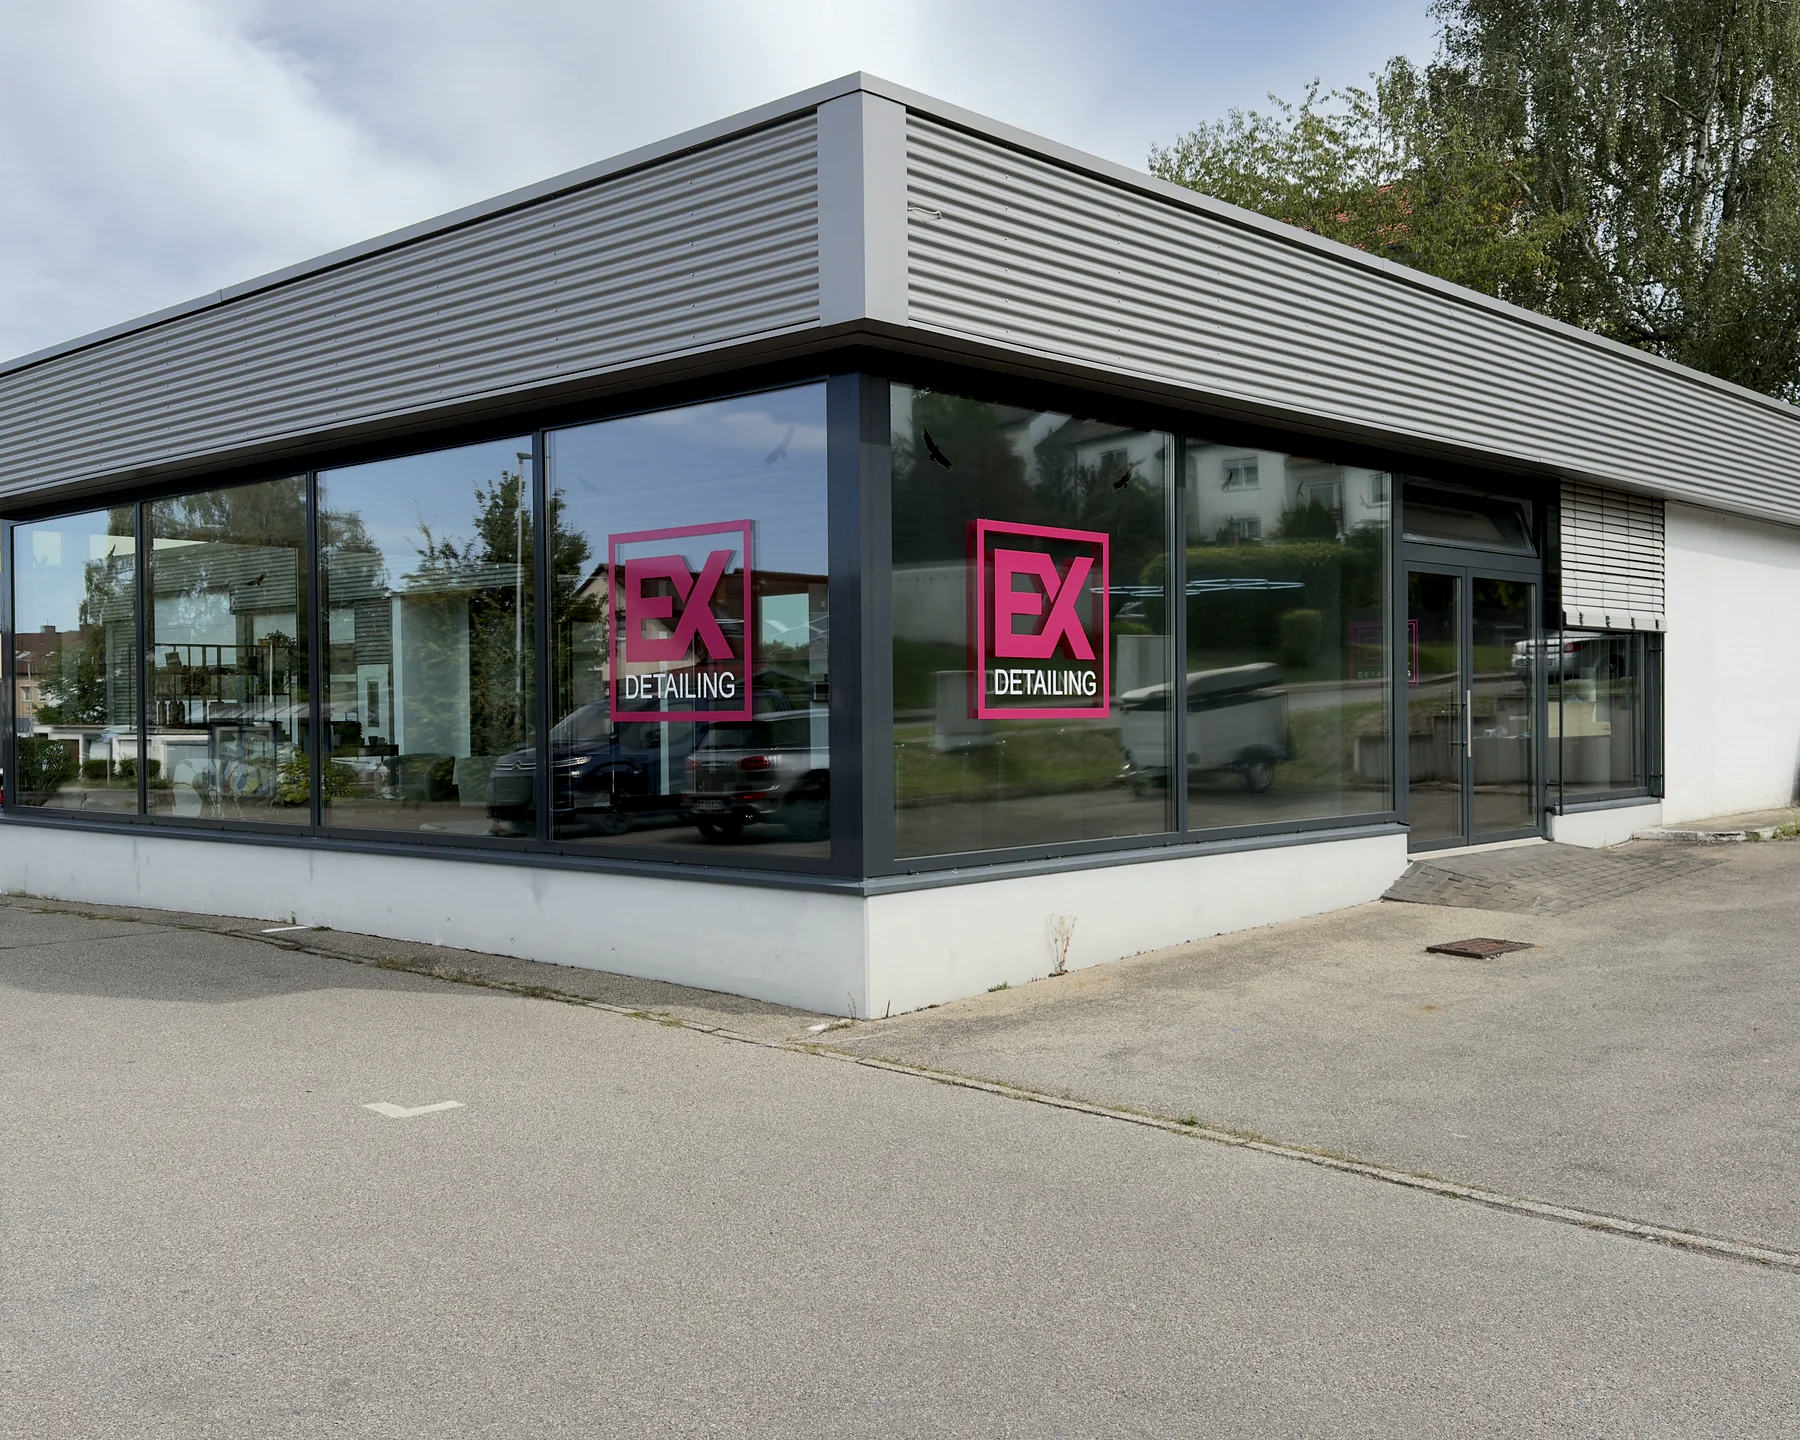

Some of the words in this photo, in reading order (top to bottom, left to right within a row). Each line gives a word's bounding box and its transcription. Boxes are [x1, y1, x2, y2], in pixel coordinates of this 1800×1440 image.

[625, 549, 735, 663] EX
[994, 548, 1096, 661] EX
[625, 671, 736, 700] DETAILING
[994, 669, 1097, 697] DETAILING
